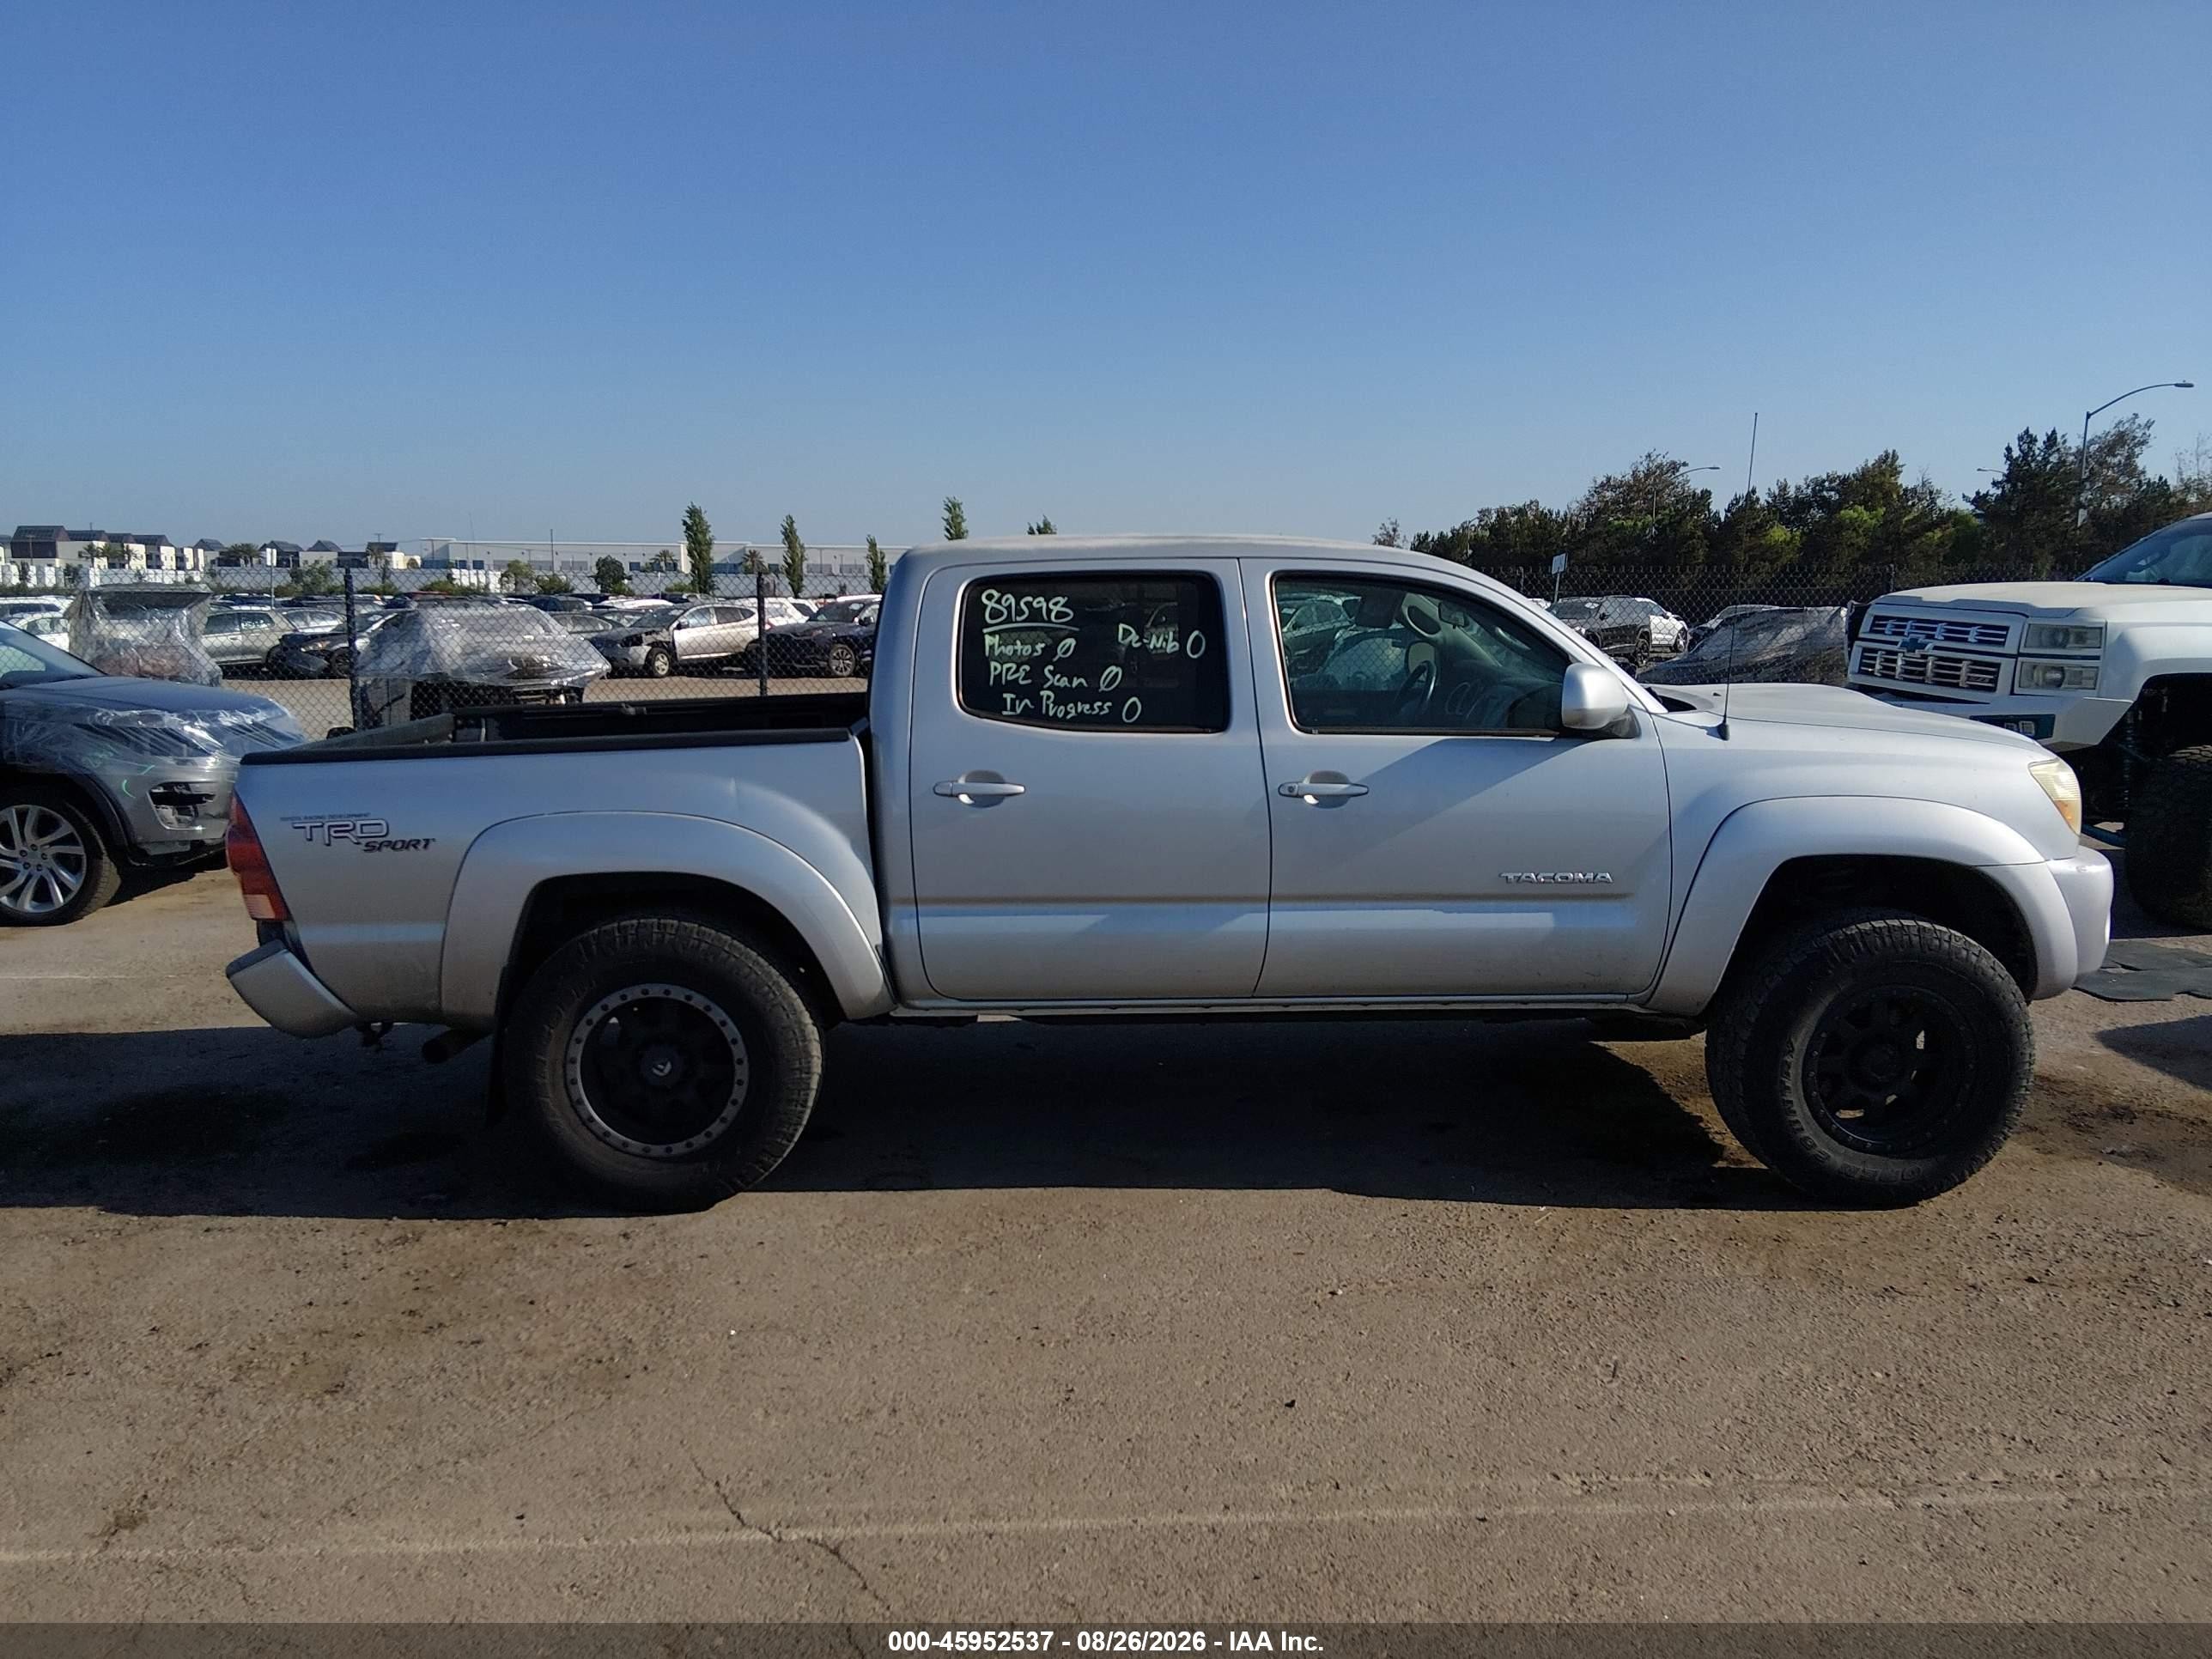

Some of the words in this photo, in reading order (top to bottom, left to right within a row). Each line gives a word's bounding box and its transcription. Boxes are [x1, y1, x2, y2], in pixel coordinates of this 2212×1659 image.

[981, 588, 1074, 624] 89598
[984, 634, 1045, 657] Photos
[1043, 665, 1088, 688] Scan
[1002, 693, 1034, 715] In
[1040, 690, 1112, 720] Progress
[292, 818, 389, 846] TRD
[362, 838, 435, 853] SPORT
[1498, 872, 1614, 884] TACOMA
